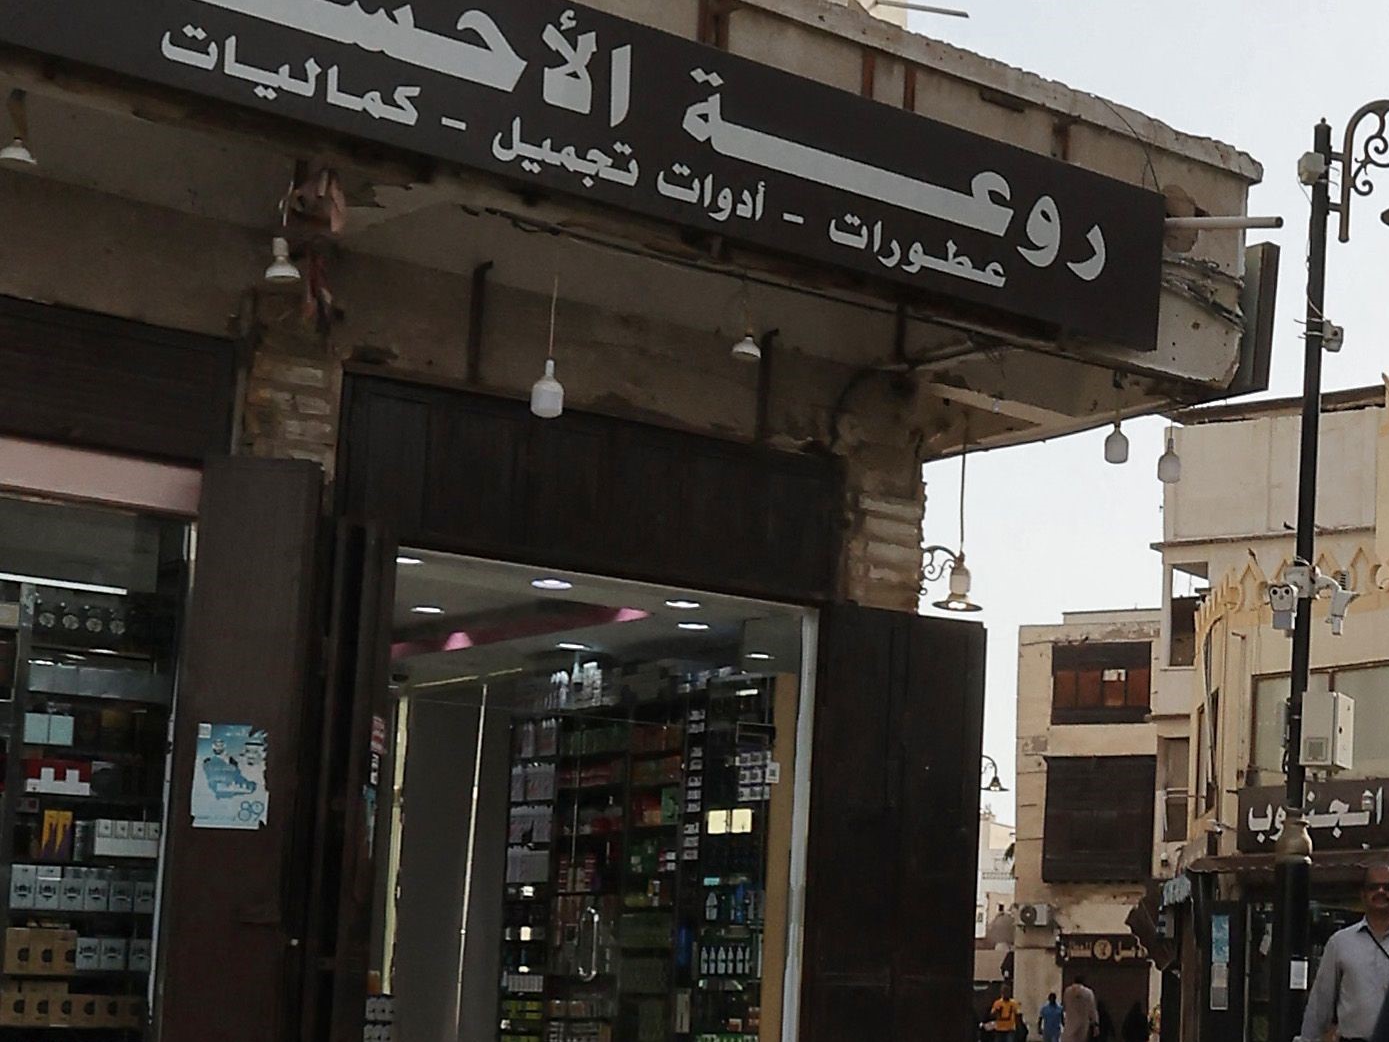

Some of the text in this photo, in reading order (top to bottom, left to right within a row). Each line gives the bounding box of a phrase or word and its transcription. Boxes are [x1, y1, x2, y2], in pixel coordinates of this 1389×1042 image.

[160, 24, 421, 127] كماليات
[491, 116, 640, 187] تجميل
[682, 67, 1107, 282] روعة
[657, 159, 767, 222] أدوات
[829, 212, 1007, 288] عطورات
[238, 801, 265, 822] 89
